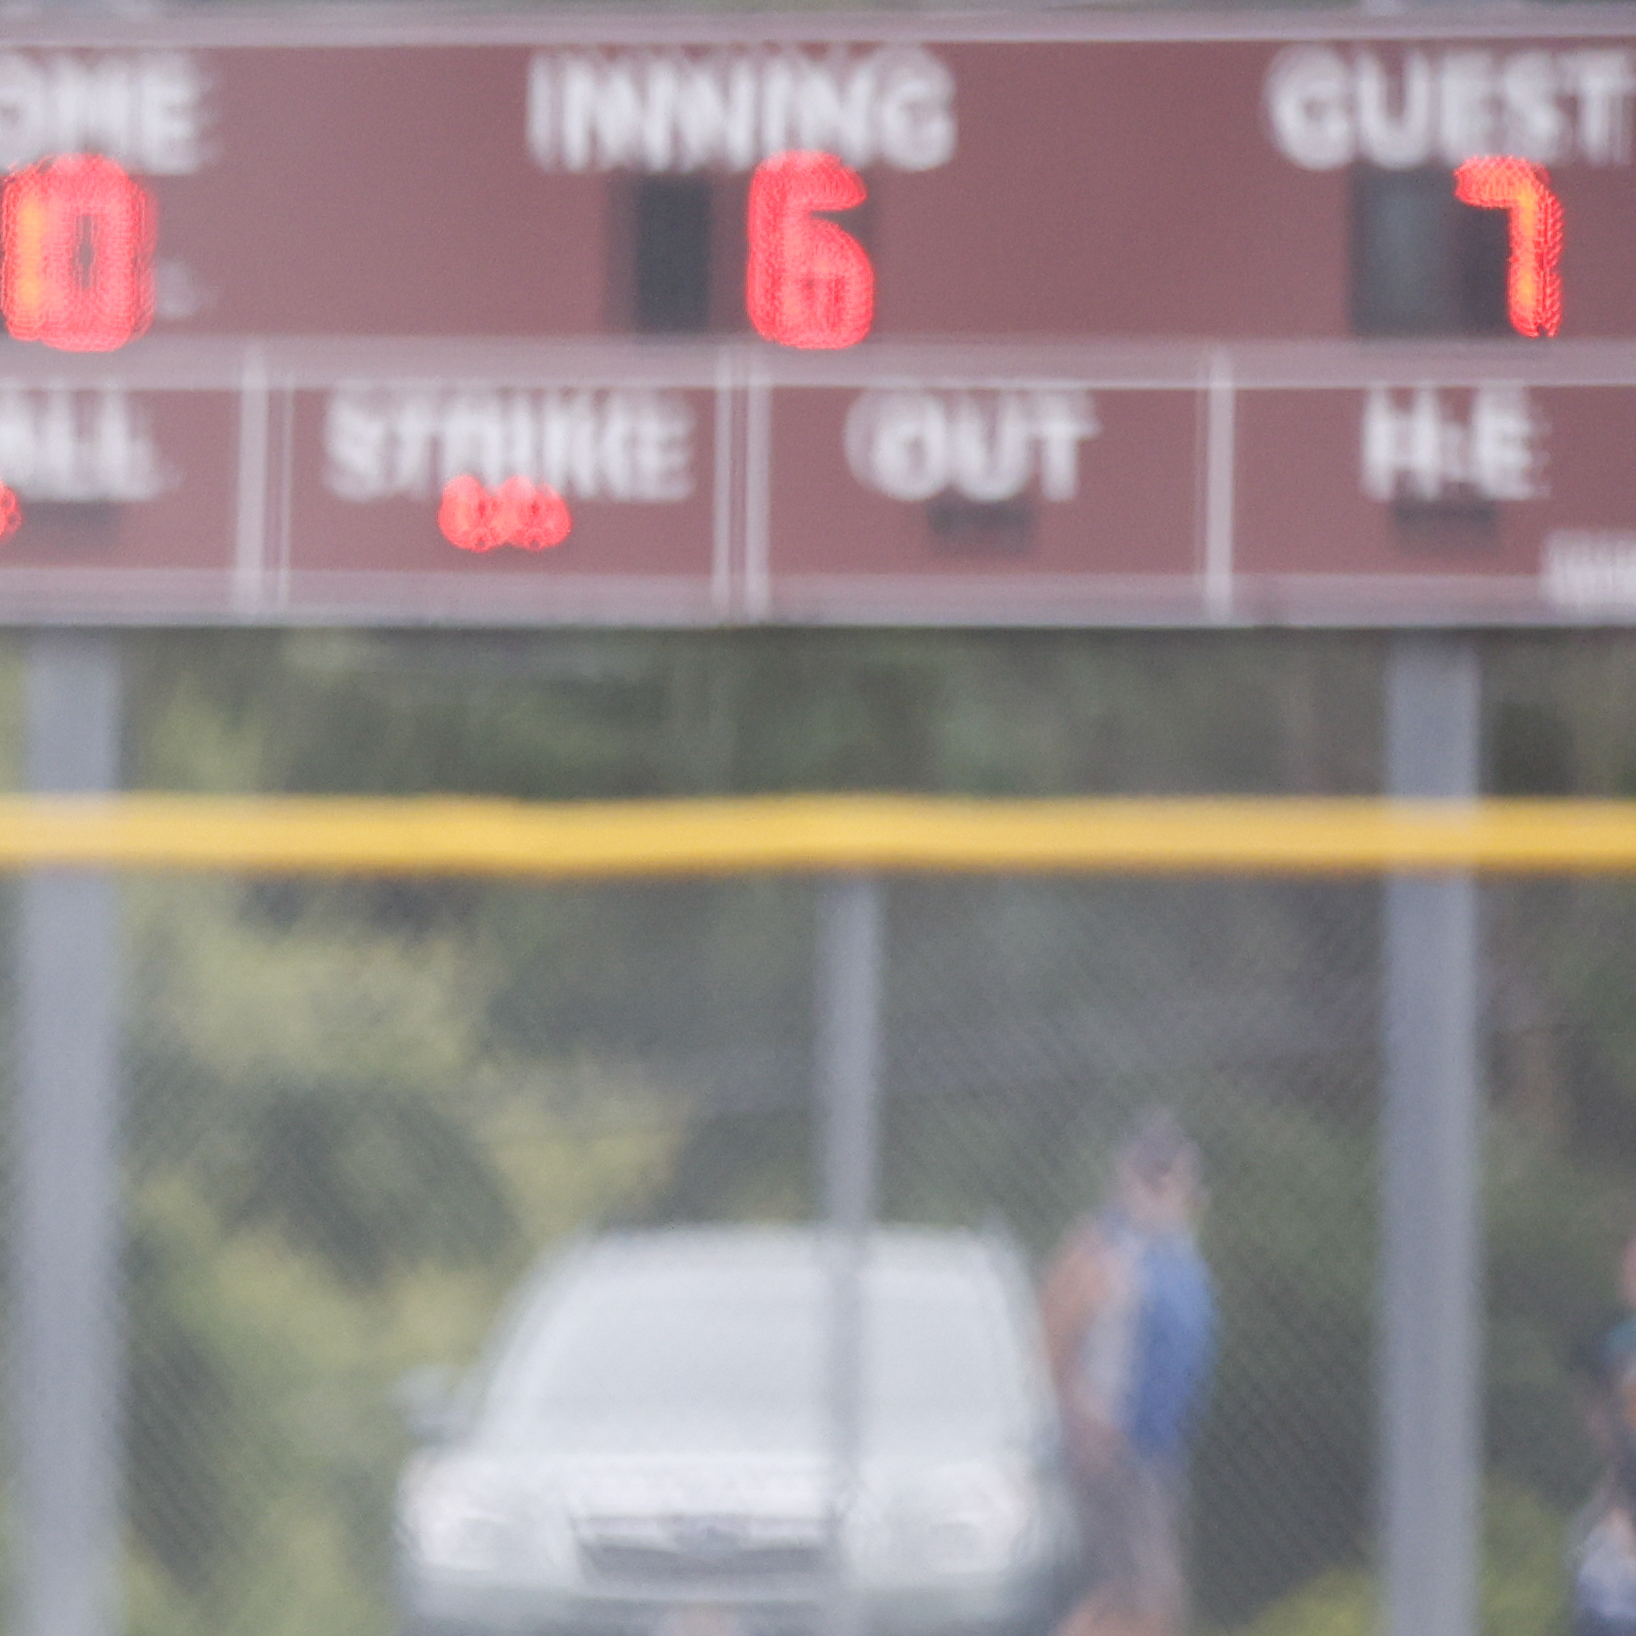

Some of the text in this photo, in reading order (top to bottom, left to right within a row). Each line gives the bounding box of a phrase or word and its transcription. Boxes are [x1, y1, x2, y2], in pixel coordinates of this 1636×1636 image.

[527, 46, 957, 172] INNING
[1265, 44, 1635, 170] GUEST
[746, 150, 875, 350] 6
[1453, 154, 1565, 339] 7
[327, 388, 695, 502] STRIKE
[845, 386, 1099, 502] OUT
